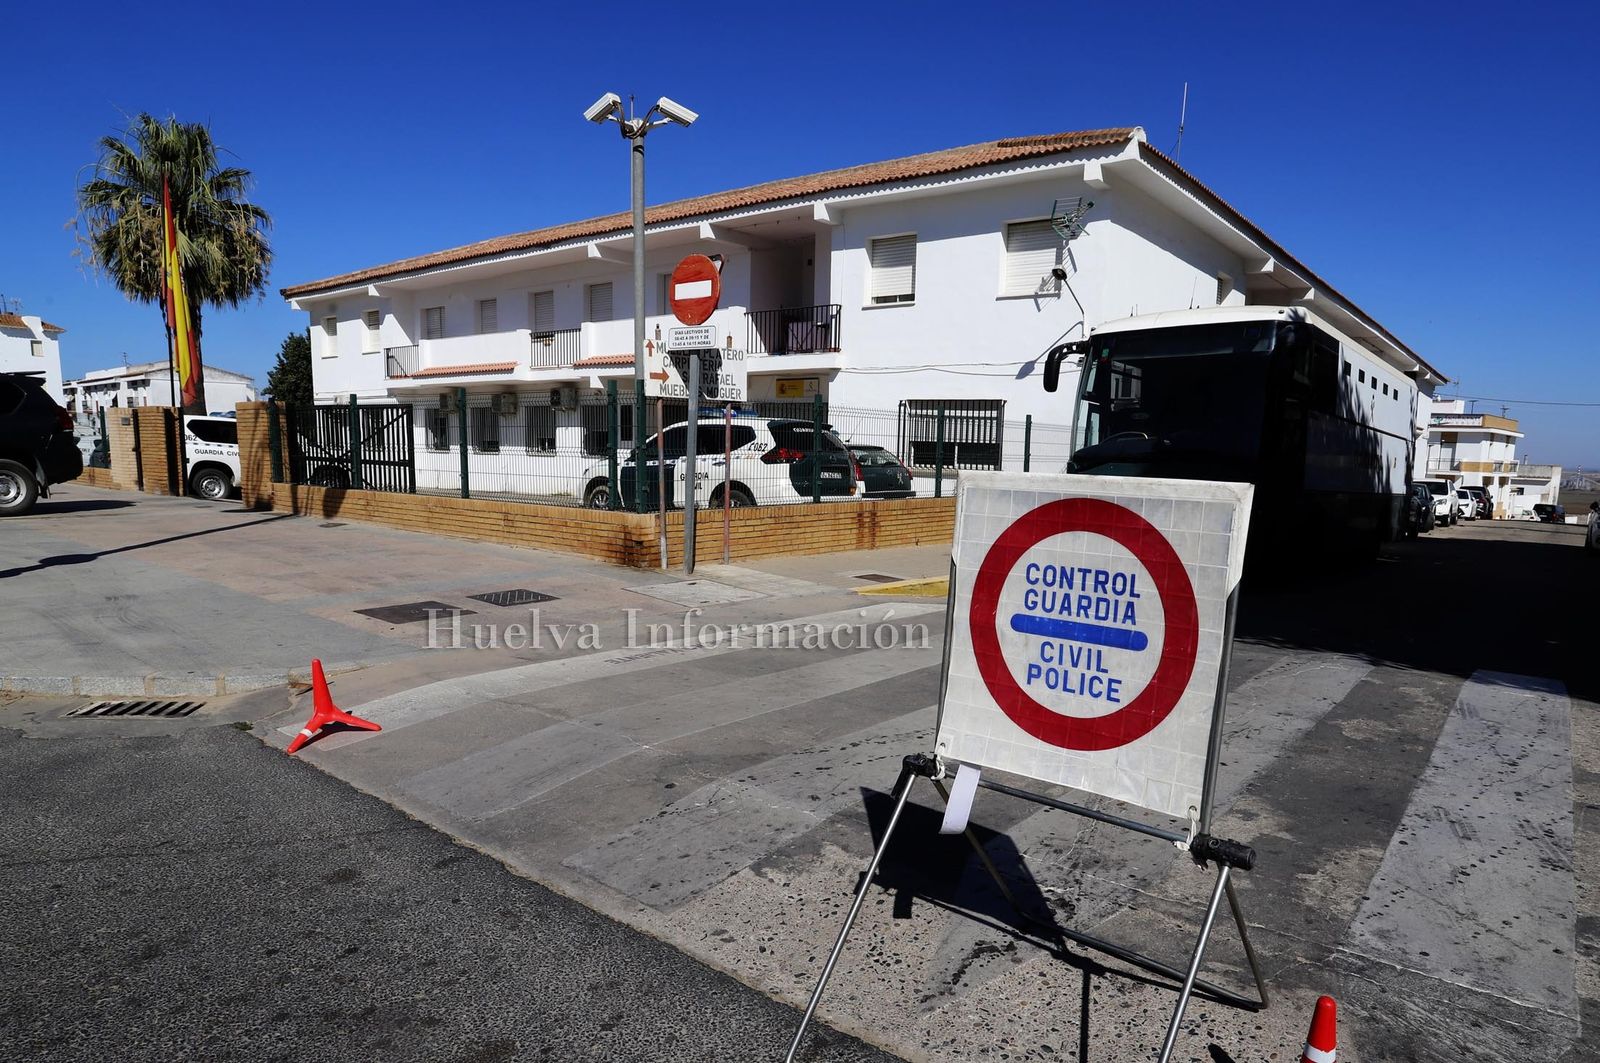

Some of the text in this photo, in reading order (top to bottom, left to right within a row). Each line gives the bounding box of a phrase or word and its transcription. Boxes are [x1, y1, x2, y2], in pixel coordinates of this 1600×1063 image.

[704, 348, 744, 360] PLATERO
[662, 356, 722, 372] CARPIERIA
[703, 373, 736, 386] RAFAEL
[660, 384, 741, 400] MUEBLS MOGUER
[680, 472, 708, 481] GRDIA
[1025, 562, 1141, 598] CONTROL
[1024, 588, 1137, 625] GUARDIA
[1040, 641, 1109, 673] CIVIL
[1026, 664, 1122, 703] POLICE
